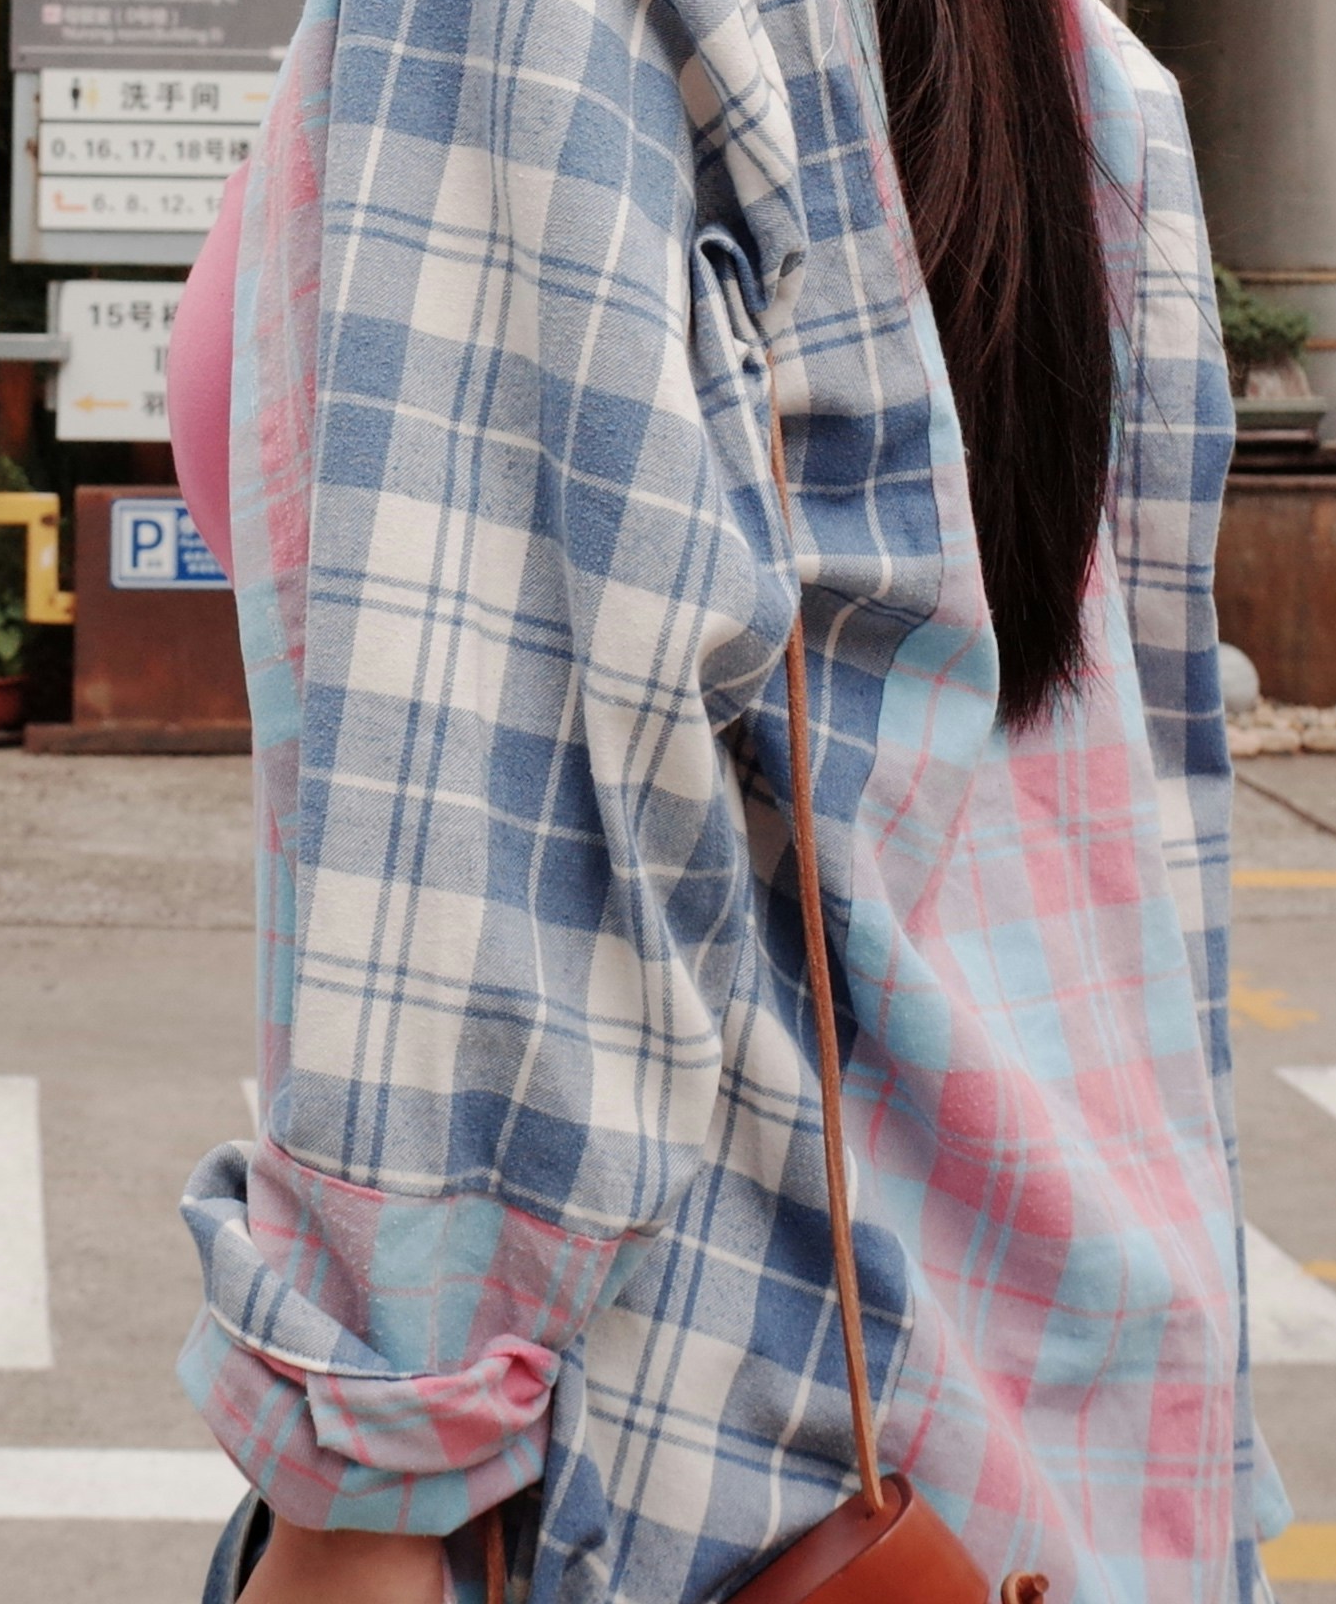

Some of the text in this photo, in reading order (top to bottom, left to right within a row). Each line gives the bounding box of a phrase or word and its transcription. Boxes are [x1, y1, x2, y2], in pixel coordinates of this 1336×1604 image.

[121, 81, 220, 112] 洗手间
[132, 518, 164, 569] P
